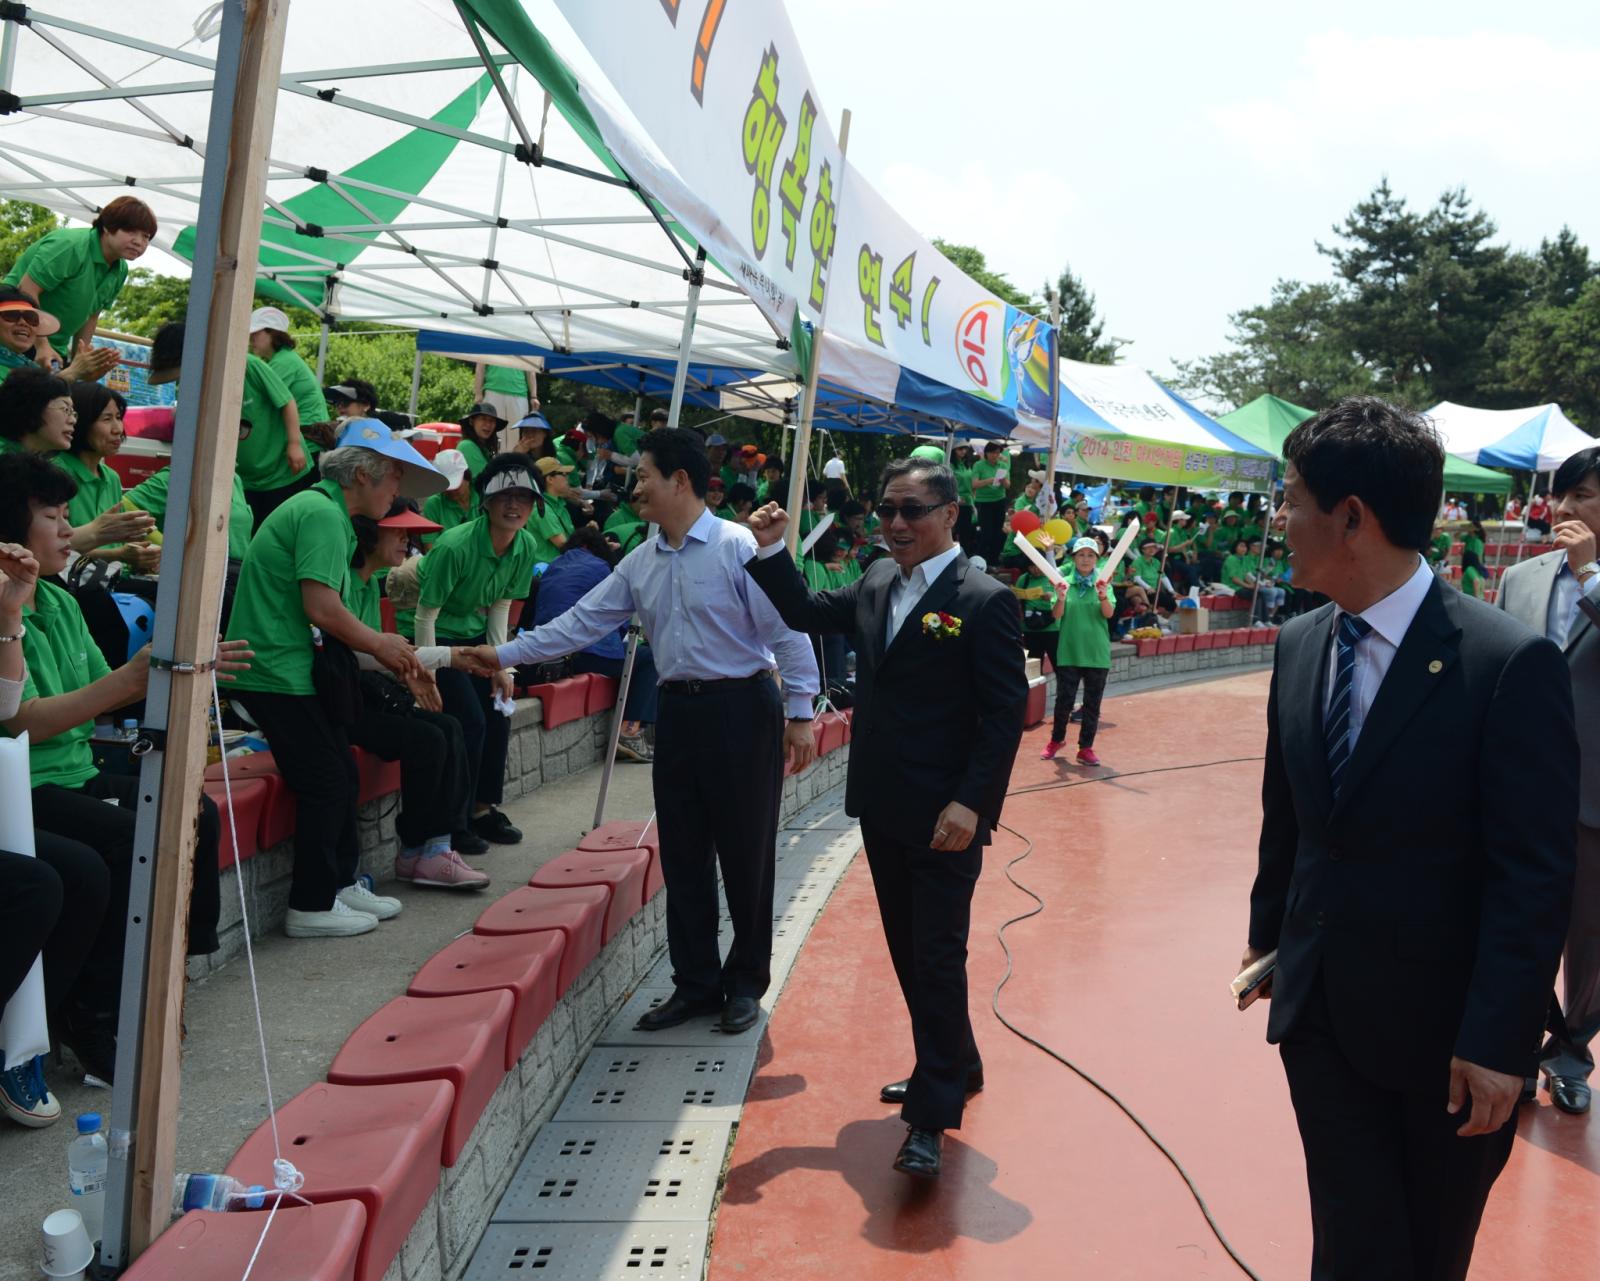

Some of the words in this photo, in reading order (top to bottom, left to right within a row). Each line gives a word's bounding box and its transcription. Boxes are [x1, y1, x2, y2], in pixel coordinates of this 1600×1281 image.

[740, 40, 838, 314] 행복한
[857, 243, 942, 348] 연수!
[1081, 436, 1109, 457] 2014
[1113, 440, 1133, 462] 인천
[1136, 444, 1184, 470] 아시안게임
